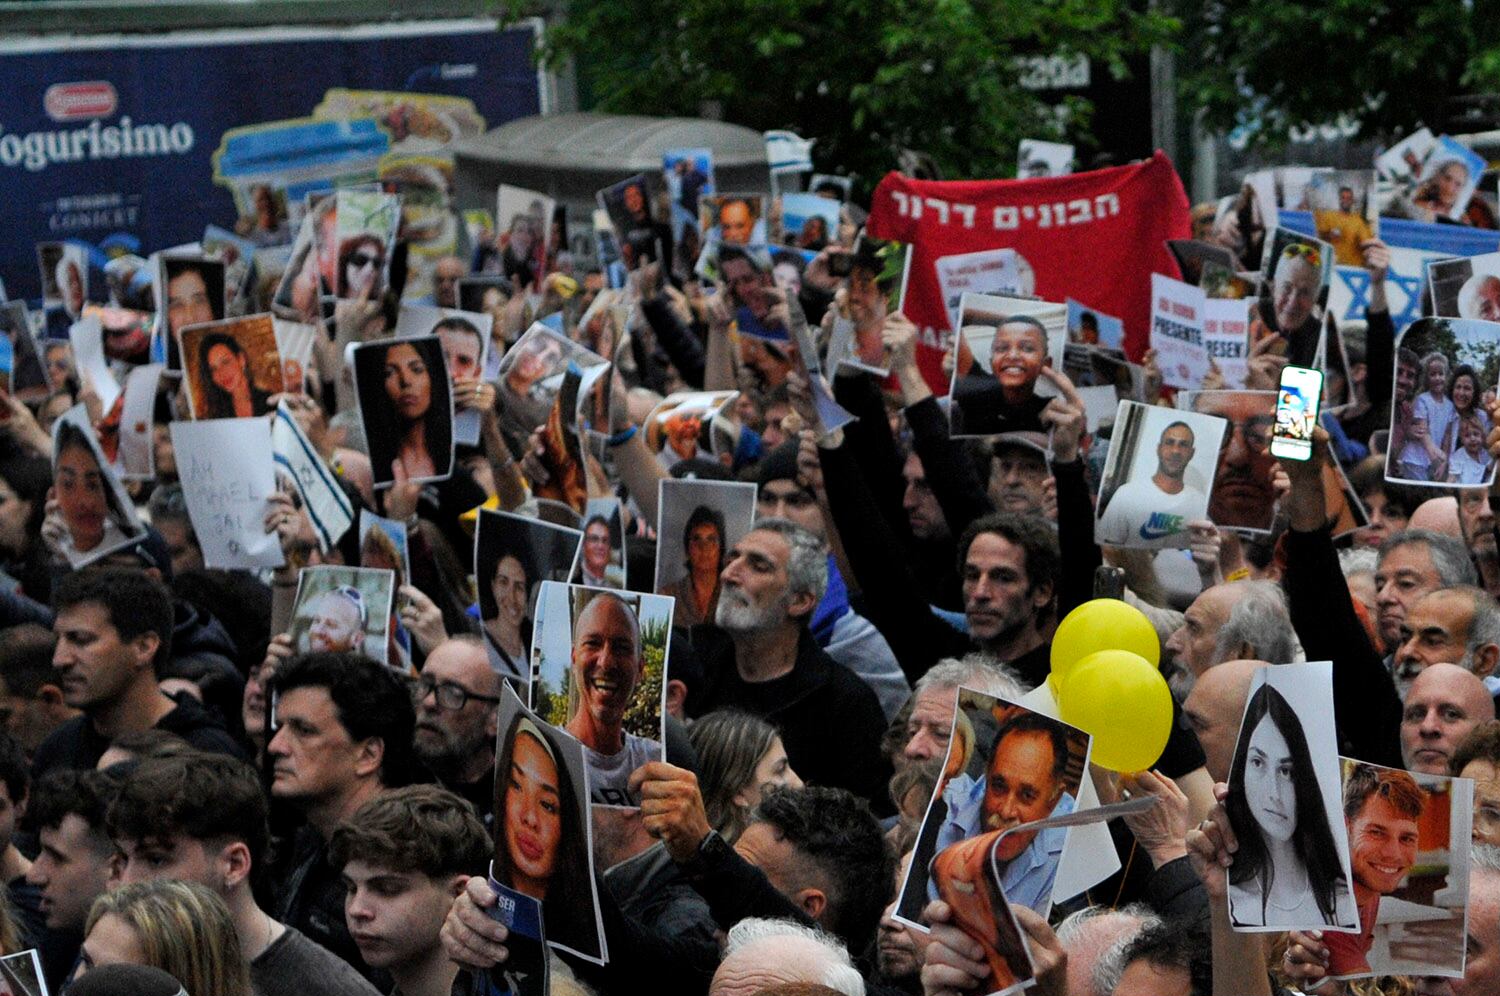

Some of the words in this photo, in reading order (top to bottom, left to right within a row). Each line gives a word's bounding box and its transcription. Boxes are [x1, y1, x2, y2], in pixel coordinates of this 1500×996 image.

[0, 115, 195, 172] ogurísimo
[891, 190, 977, 229] דרור
[993, 192, 1121, 231] הבונים
[1154, 315, 1203, 347] PRESENTE
[1147, 511, 1185, 533] NIKE
[497, 895, 516, 913] SER
